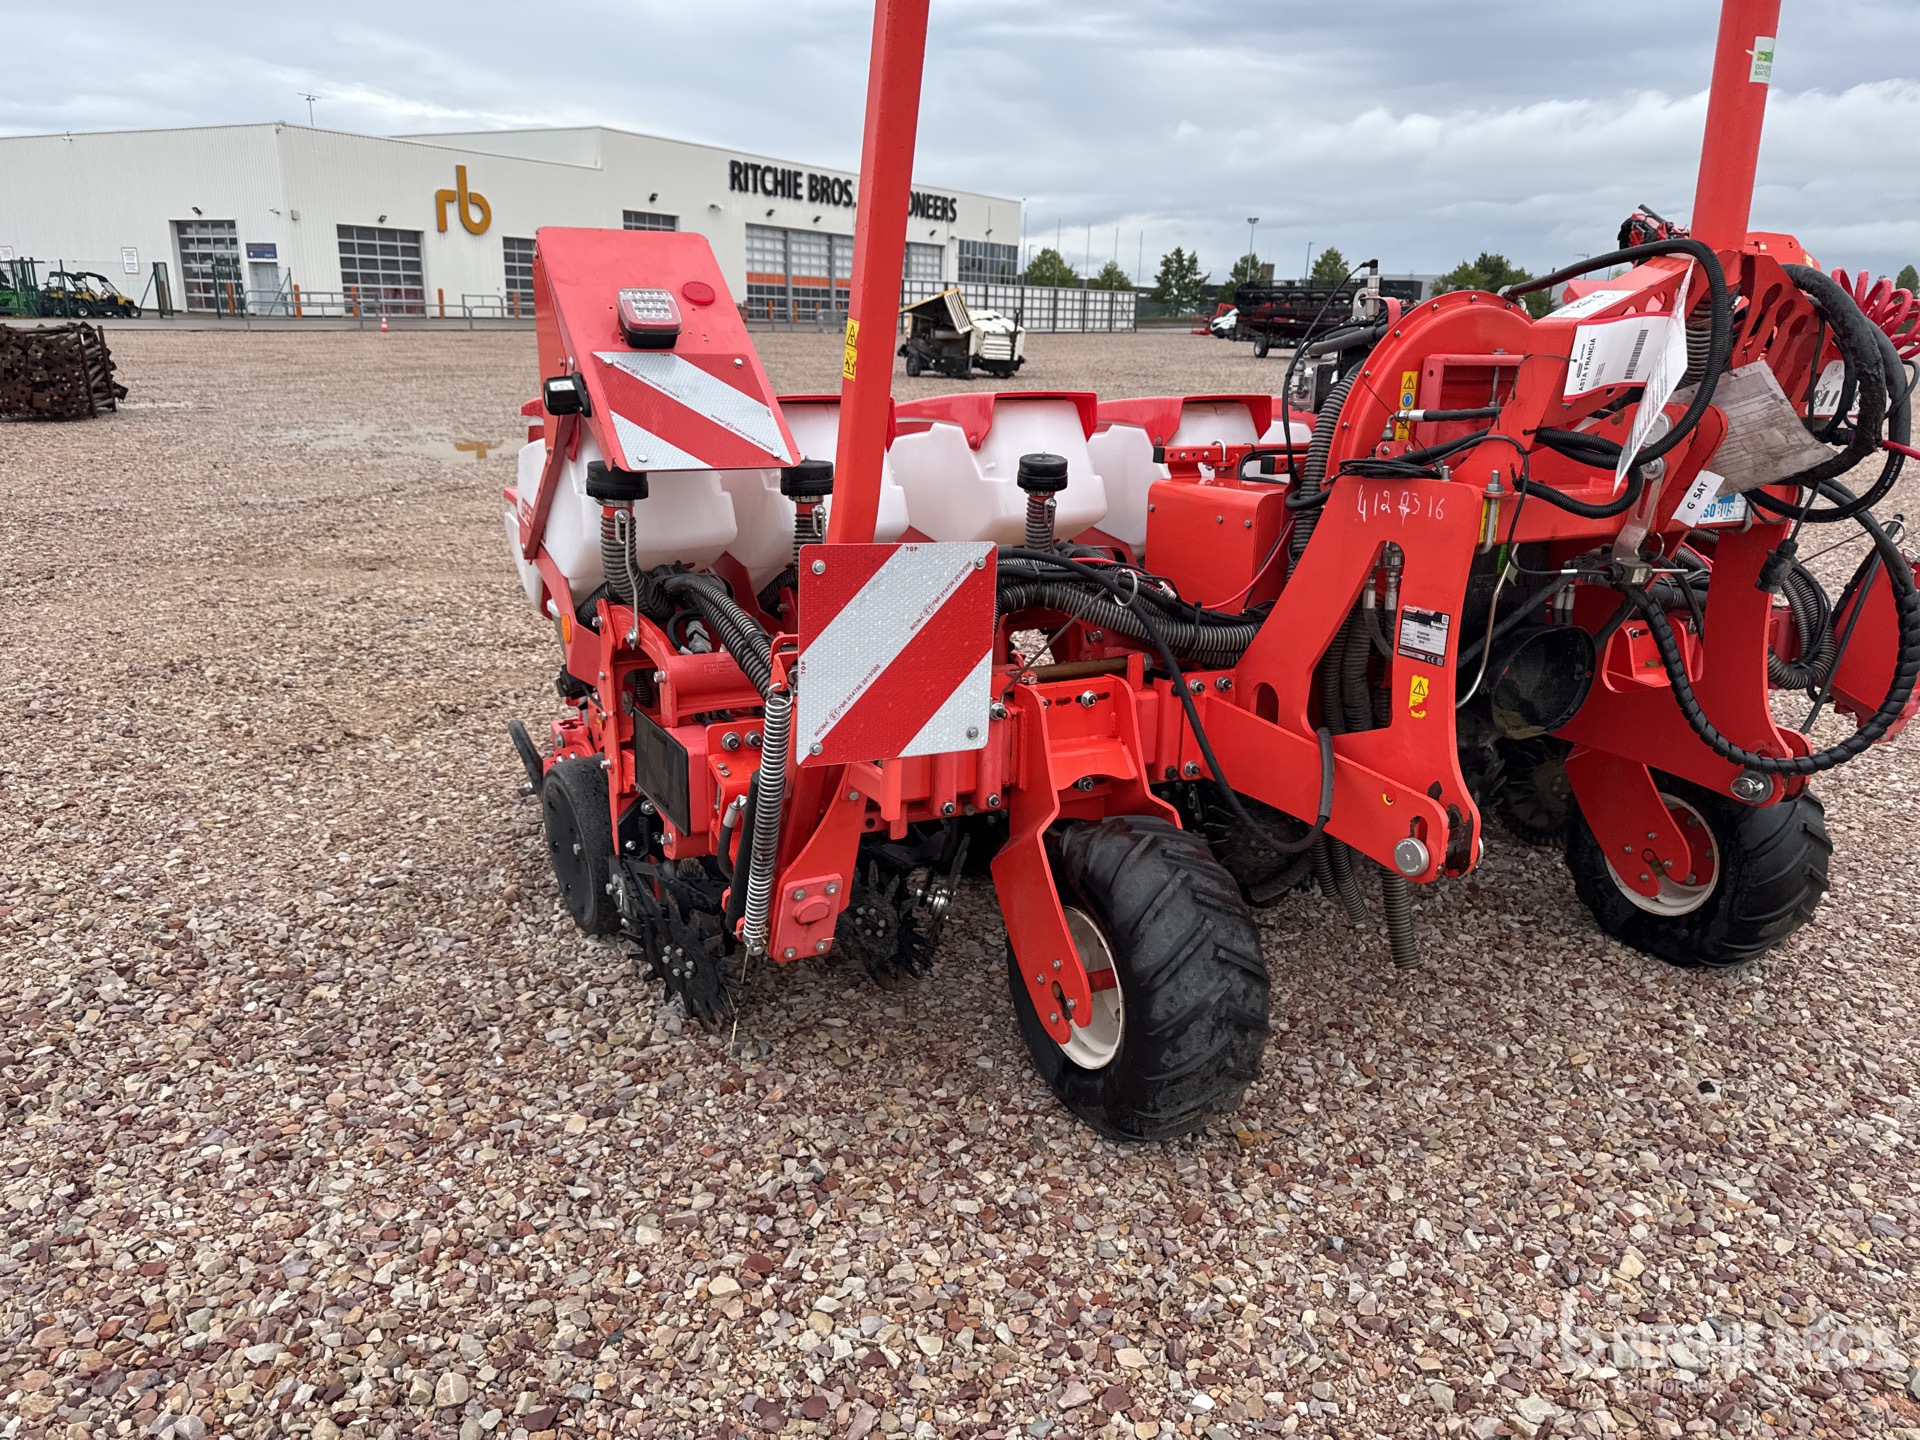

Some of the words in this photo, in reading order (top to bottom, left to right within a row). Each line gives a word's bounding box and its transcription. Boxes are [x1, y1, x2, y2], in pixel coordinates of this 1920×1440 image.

[435, 165, 492, 236] rb
[729, 160, 803, 200] RITCHIE
[807, 173, 857, 208] BROS.
[908, 190, 957, 223] ONEERS
[1579, 372, 1588, 391] ASTA
[1584, 338, 1597, 370] FRANCIA
[1686, 501, 1696, 510] G
[1693, 481, 1708, 500] SAT
